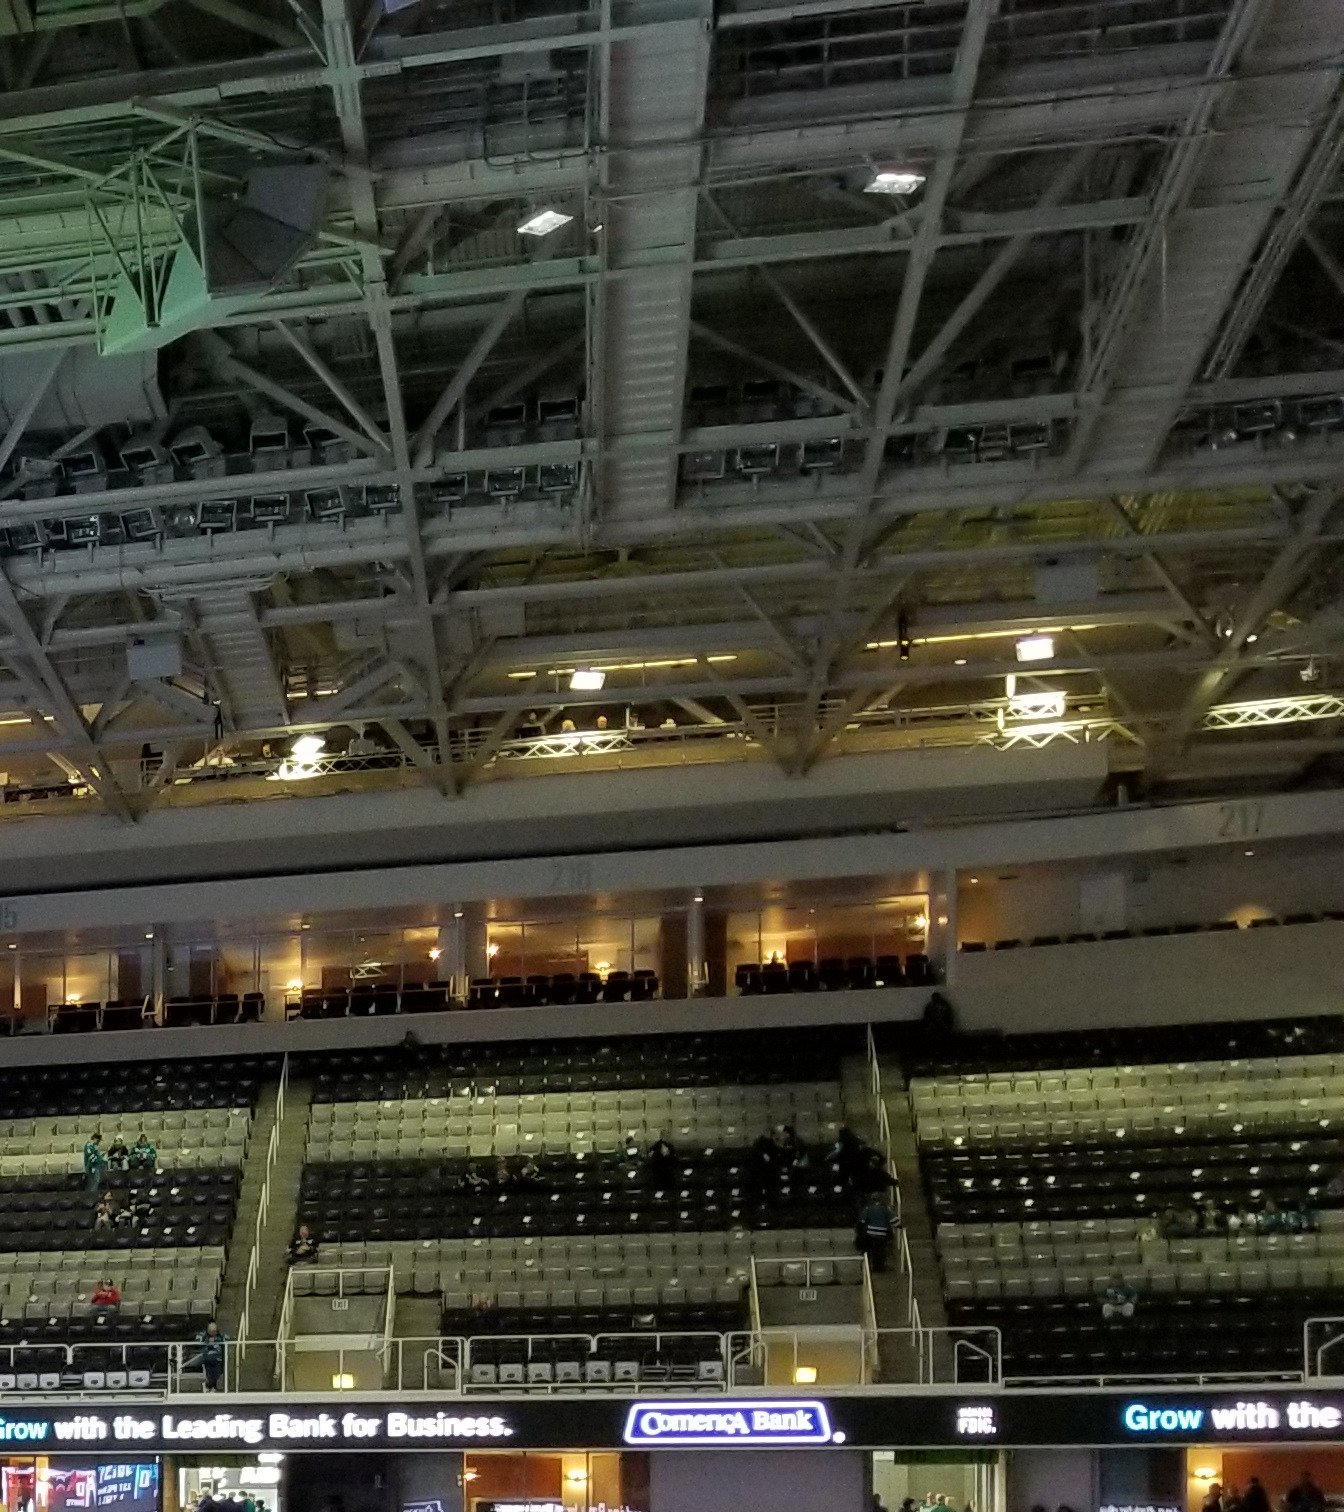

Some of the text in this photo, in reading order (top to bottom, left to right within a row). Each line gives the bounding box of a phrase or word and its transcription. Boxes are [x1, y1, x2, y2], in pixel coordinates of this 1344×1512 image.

[53, 1415, 108, 1440] with
[112, 1416, 156, 1440] the
[161, 1414, 265, 1444] Leading
[268, 1413, 337, 1438] Bank
[341, 1413, 383, 1438] for
[386, 1411, 514, 1437] Business.
[751, 1409, 815, 1432] Bank
[1123, 1400, 1343, 1431] Grow with the
